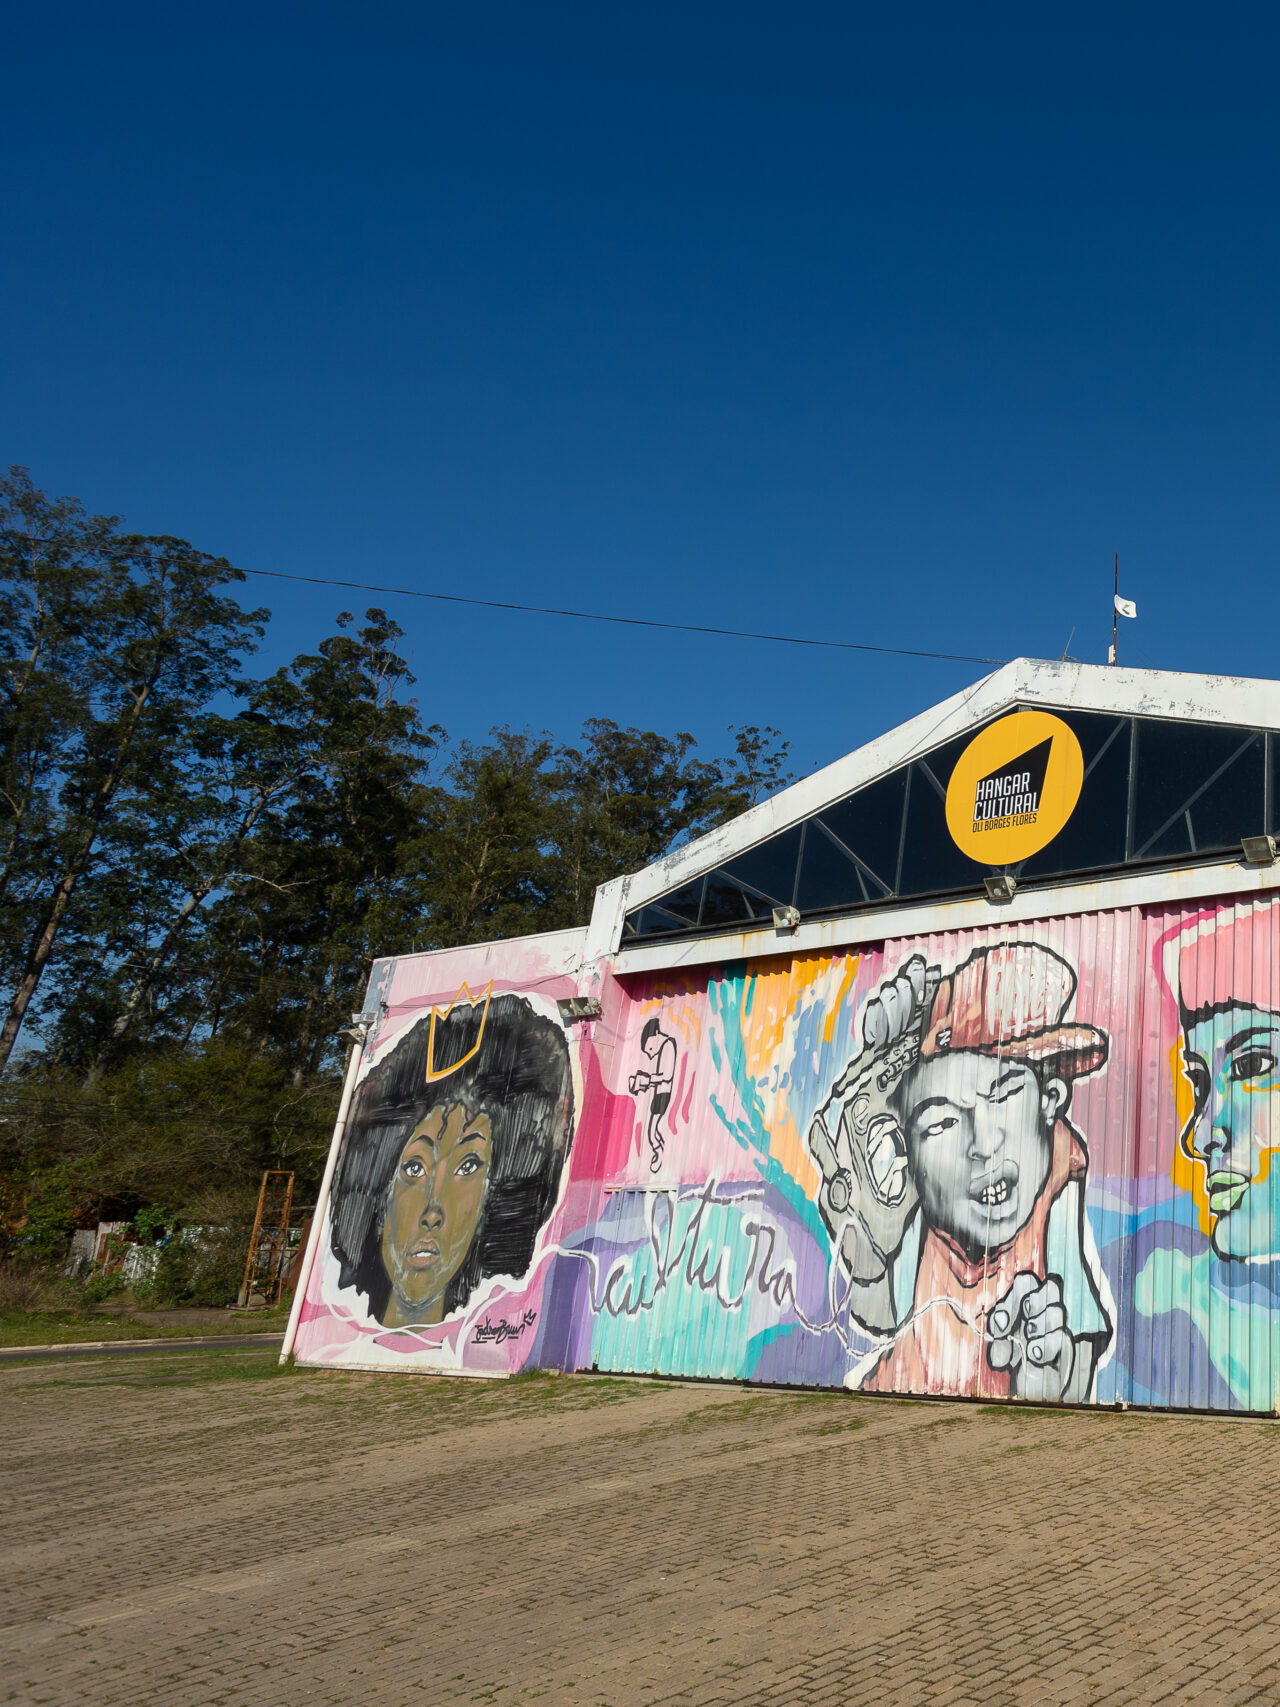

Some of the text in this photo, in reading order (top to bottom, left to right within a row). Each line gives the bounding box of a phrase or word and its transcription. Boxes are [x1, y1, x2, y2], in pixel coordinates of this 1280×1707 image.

[976, 772, 1031, 801] HANGAR
[973, 792, 1039, 821] CULTURAL
[984, 817, 1011, 831] BORGES
[1012, 813, 1037, 826] FLORES
